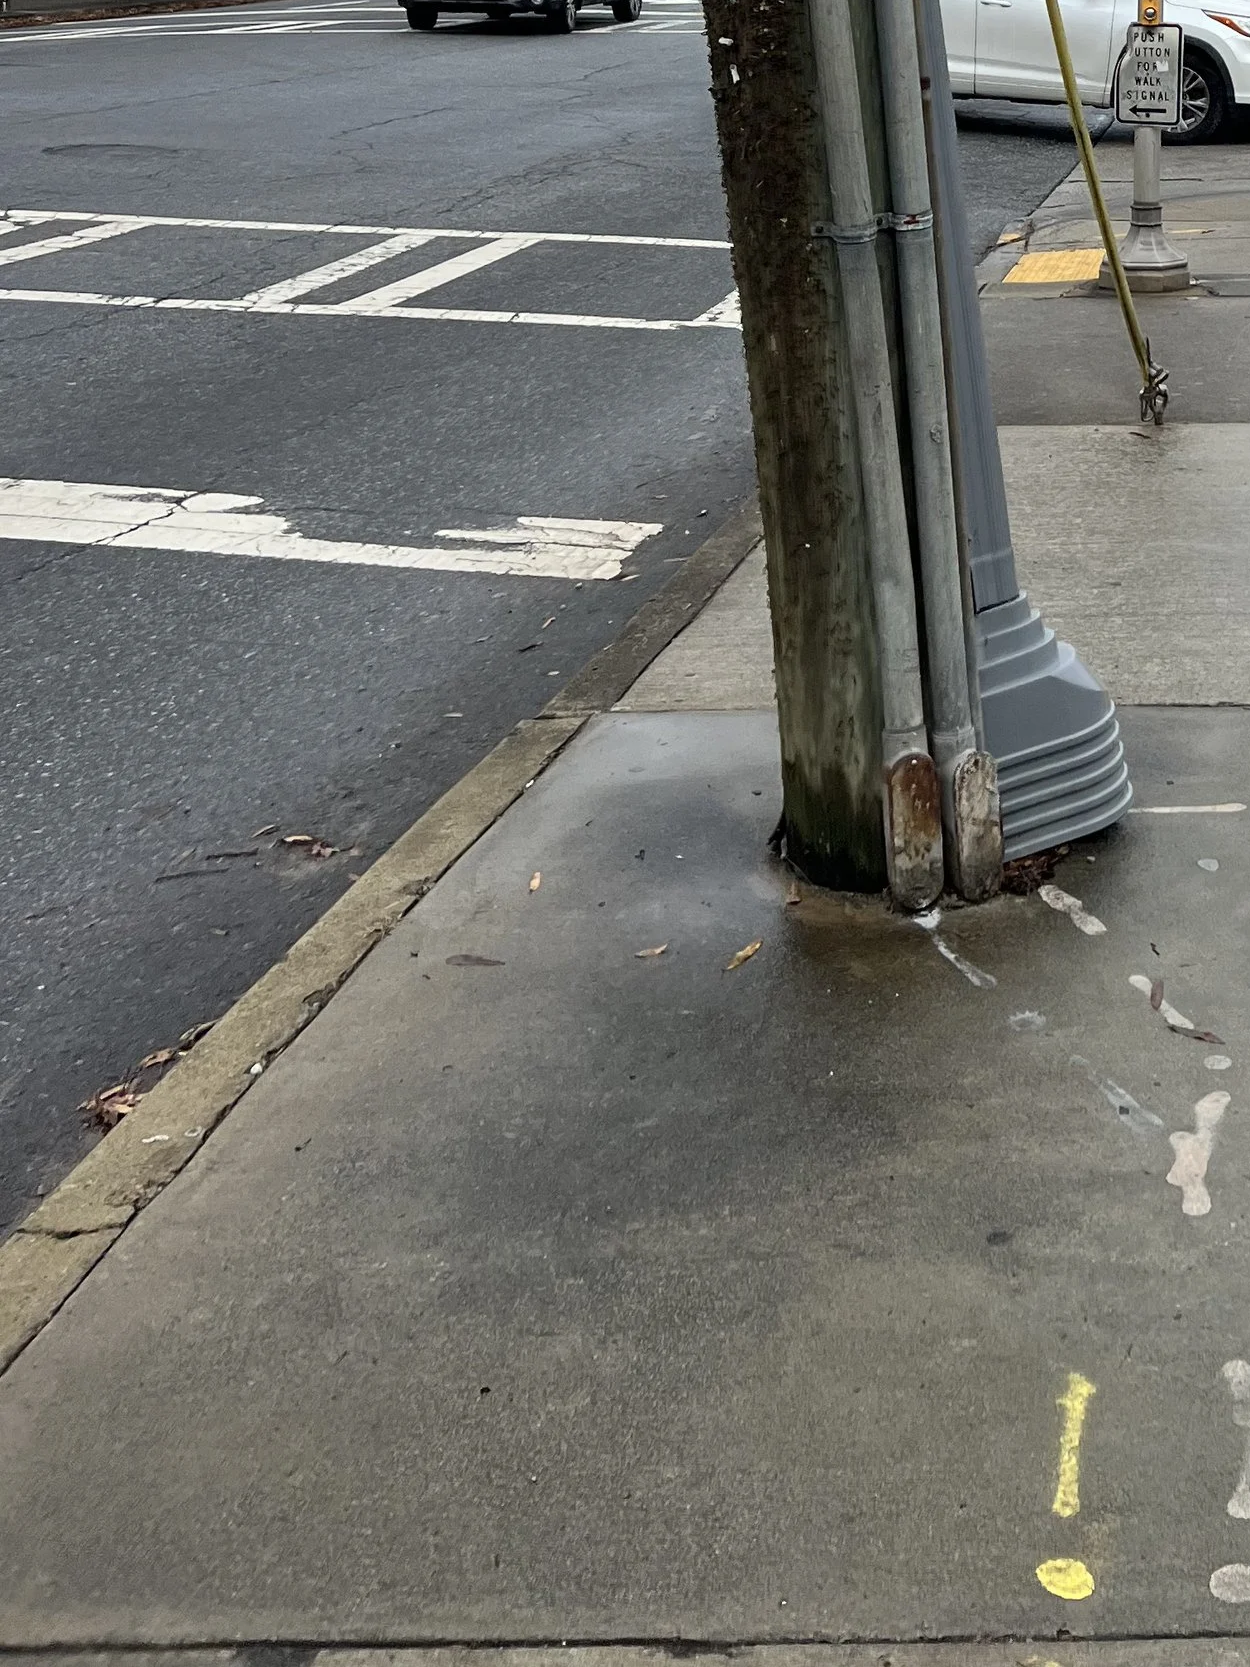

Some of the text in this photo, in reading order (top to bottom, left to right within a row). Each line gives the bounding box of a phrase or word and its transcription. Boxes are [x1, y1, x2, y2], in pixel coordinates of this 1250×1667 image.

[1133, 32, 1164, 43] PUSH
[1134, 47, 1170, 57] UTTON
[1135, 76, 1161, 86] WALK
[1126, 90, 1169, 101] SIGNAL
